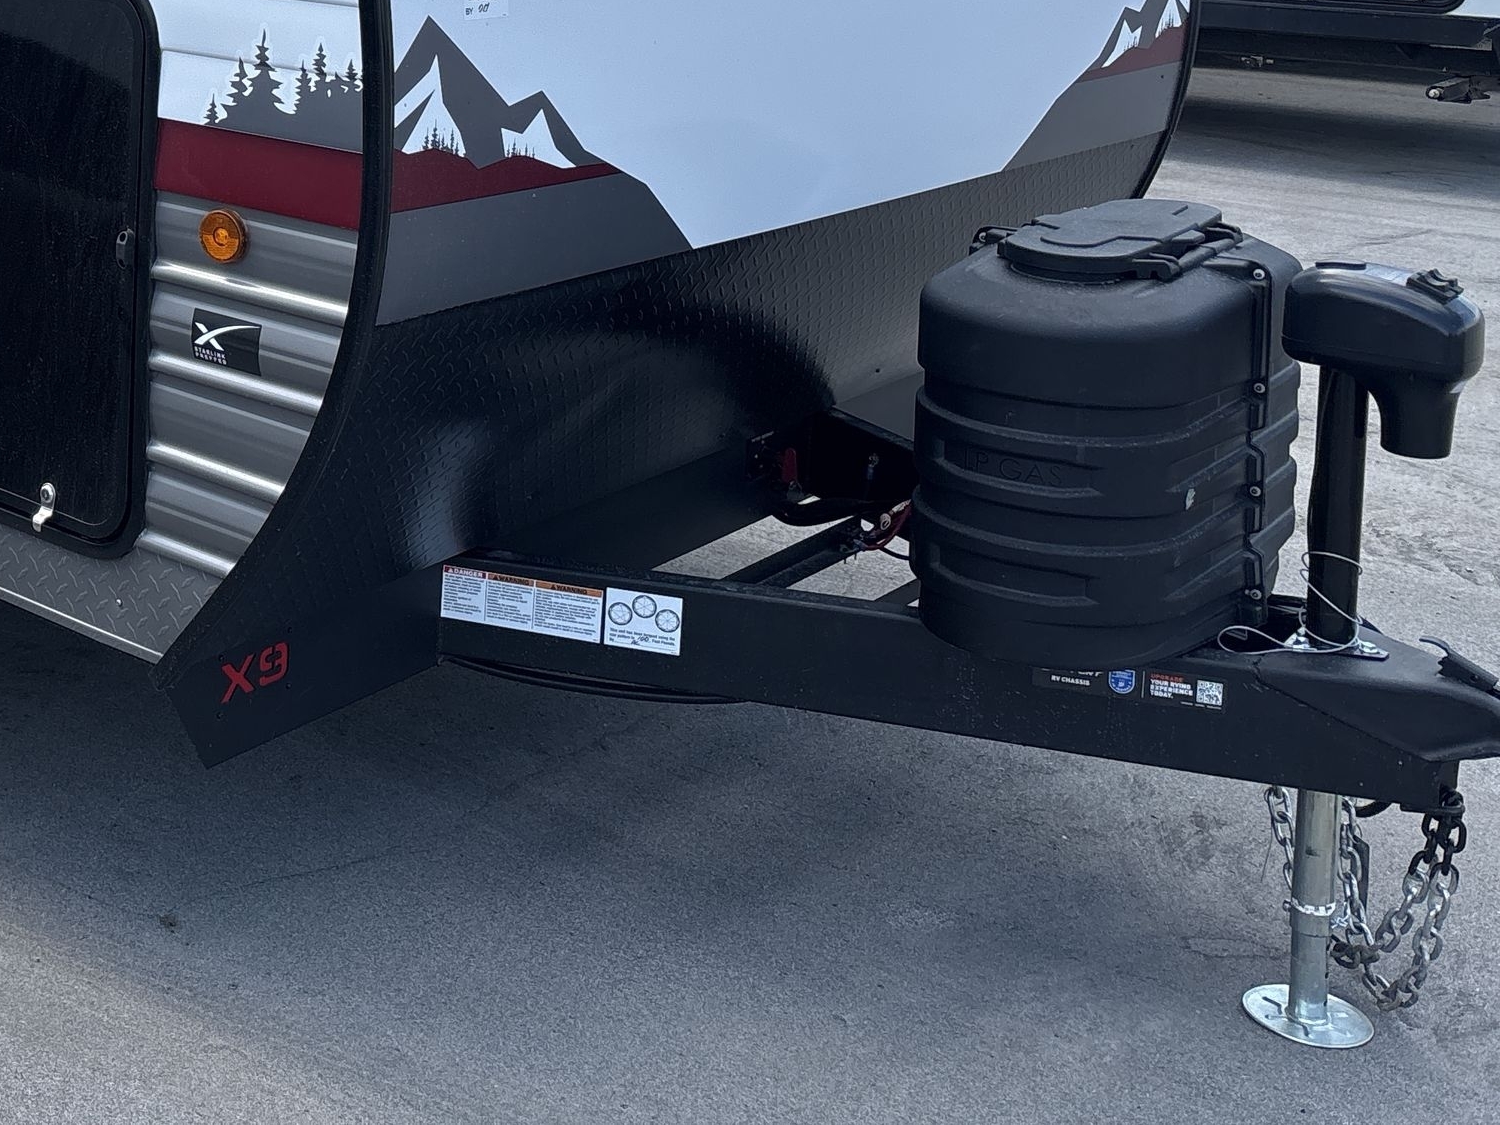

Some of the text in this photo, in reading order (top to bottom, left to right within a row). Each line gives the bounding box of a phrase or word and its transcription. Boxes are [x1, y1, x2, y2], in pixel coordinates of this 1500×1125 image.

[465, 7, 473, 15] BY
[194, 346, 225, 359] STARLINK
[999, 458, 1062, 487] GAS
[454, 568, 483, 578] DANGER
[499, 575, 530, 585] WARNING
[555, 584, 588, 595] WARNING
[1061, 677, 1090, 686] CHASSIS
[1150, 679, 1168, 687] YOUR
[1150, 684, 1193, 696] EXPERIENCE
